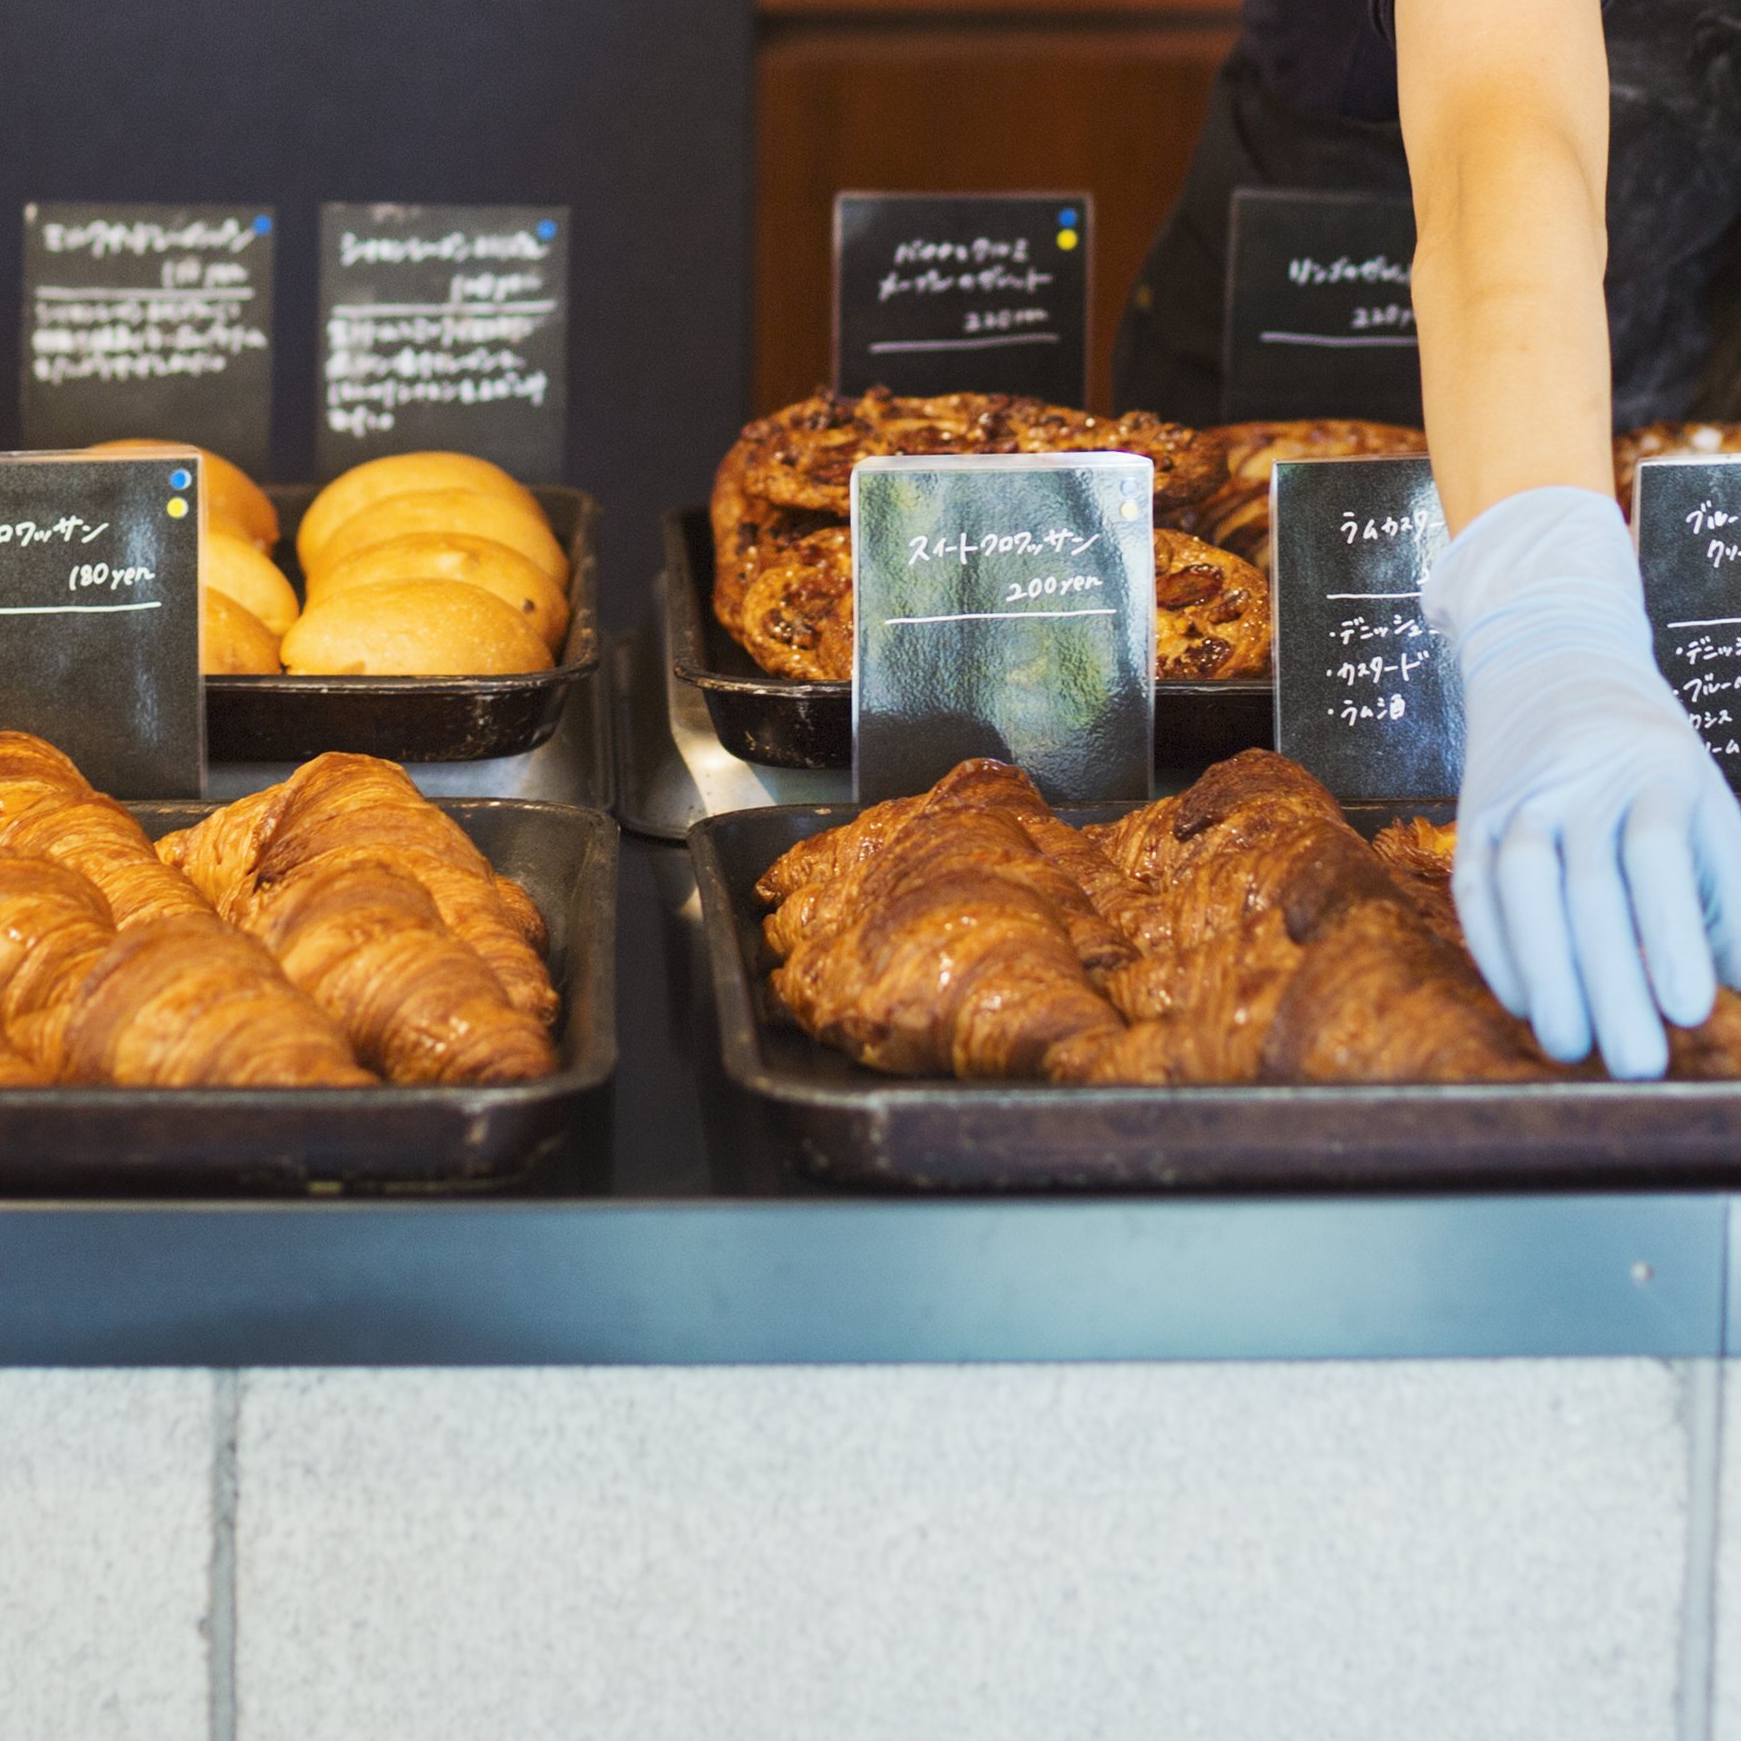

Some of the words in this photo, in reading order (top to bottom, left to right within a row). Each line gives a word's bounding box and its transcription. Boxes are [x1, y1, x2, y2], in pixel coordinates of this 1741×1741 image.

[1288, 255, 1413, 286] リンゴのガレッ
[909, 529, 1100, 565] スイートクロワッサン
[69, 562, 155, 591] 180yen
[1006, 576, 1103, 601] 200yen
[1340, 614, 1440, 645] デニッシュ
